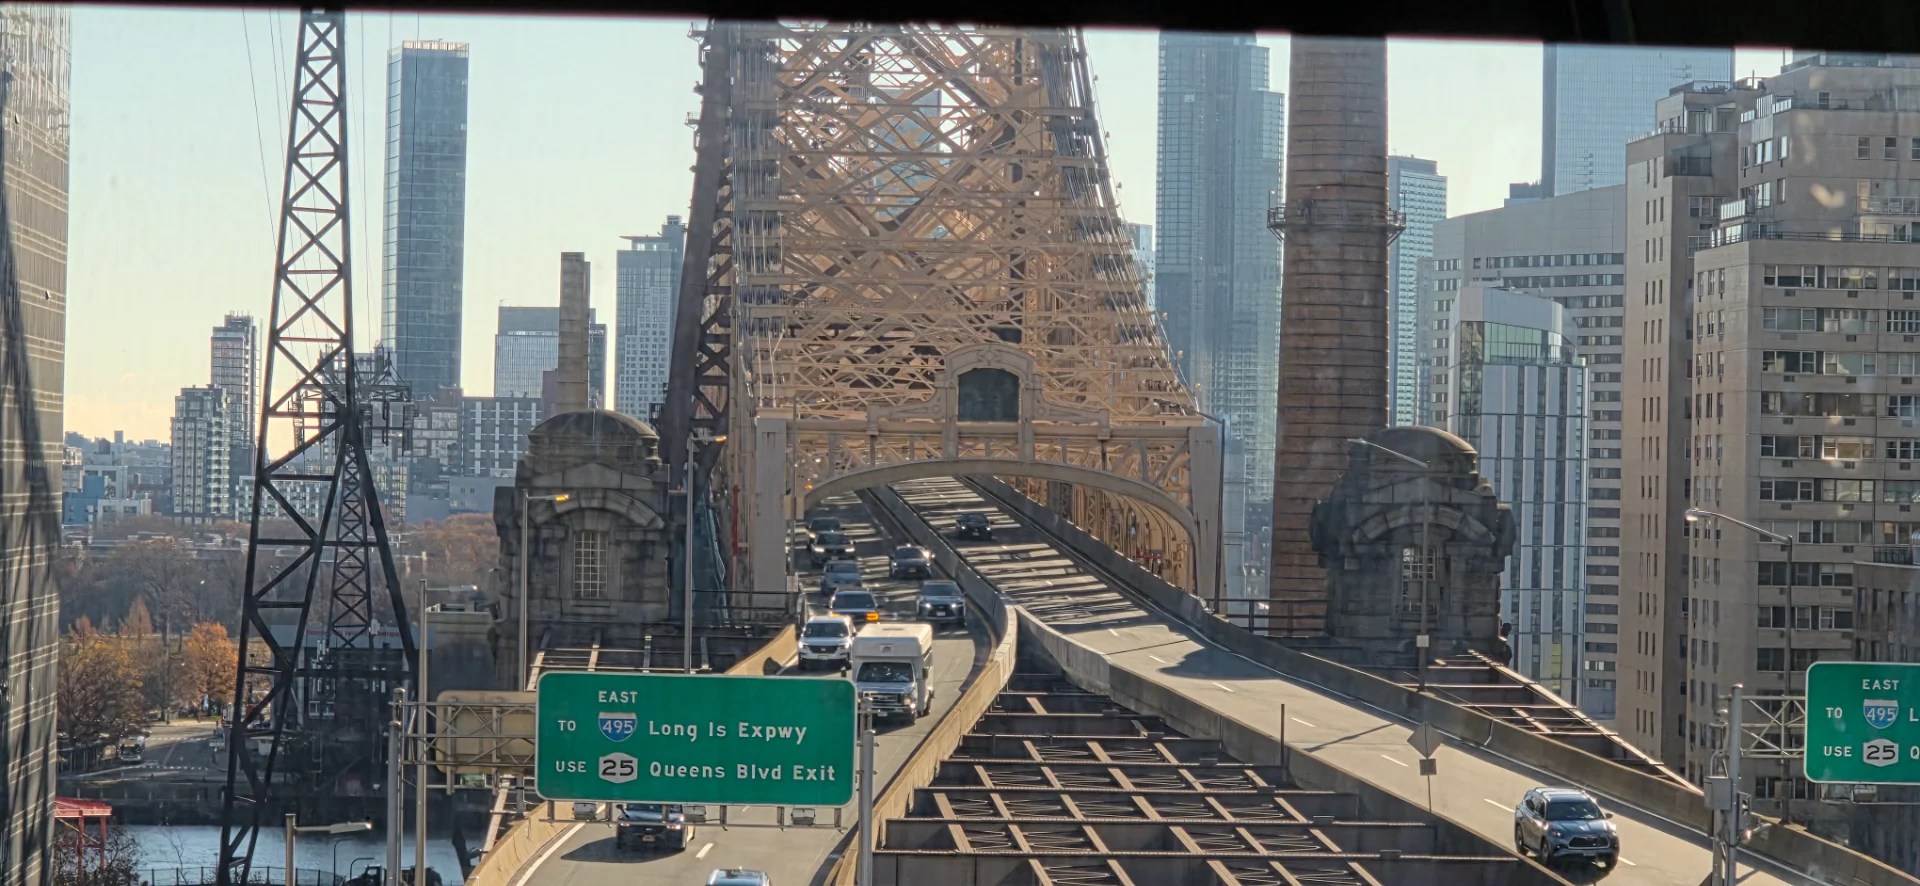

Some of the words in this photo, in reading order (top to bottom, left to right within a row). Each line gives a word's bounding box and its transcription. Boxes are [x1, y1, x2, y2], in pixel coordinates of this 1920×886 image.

[1862, 679, 1899, 690] EAST
[599, 691, 638, 703] EAST
[1825, 707, 1843, 718] TO
[1866, 707, 1896, 721] 495
[557, 720, 576, 731] TO
[602, 720, 634, 734] 495
[649, 720, 697, 741] Long
[709, 722, 727, 737] Is
[738, 723, 807, 744] Expwy
[1824, 745, 1852, 757] USE
[1866, 745, 1896, 760] 25
[556, 761, 586, 773] USE
[601, 759, 634, 776] 25
[650, 762, 725, 778] Queens
[737, 763, 782, 780] Blvd
[793, 765, 835, 781] Exit
